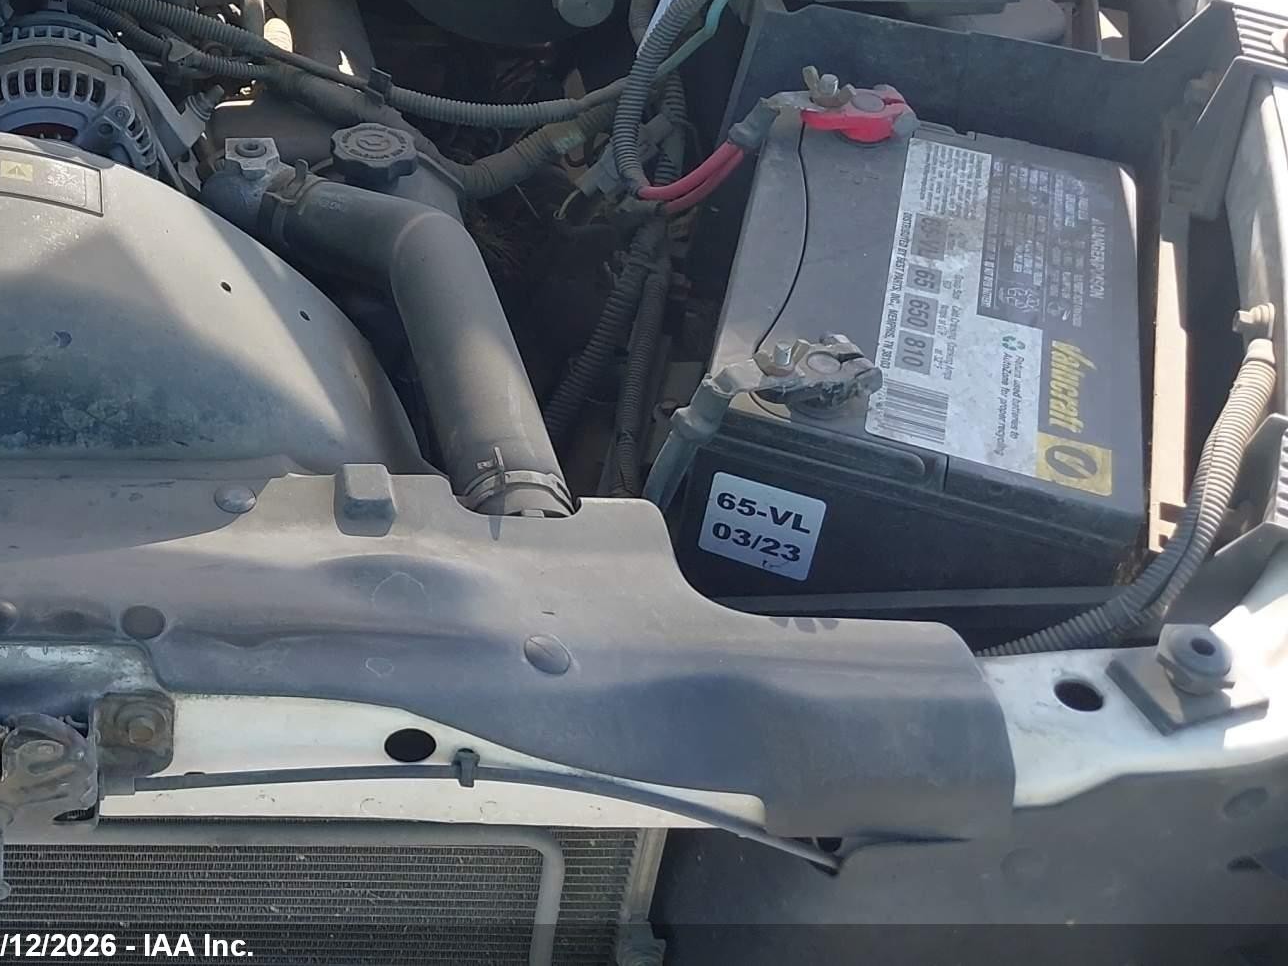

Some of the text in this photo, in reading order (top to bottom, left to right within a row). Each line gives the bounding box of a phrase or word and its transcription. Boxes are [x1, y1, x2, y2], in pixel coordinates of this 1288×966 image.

[894, 256, 905, 272] BEST
[914, 268, 935, 289] 65
[906, 298, 929, 328] 650
[901, 336, 925, 367] 810
[1000, 351, 1012, 386] AutoZone
[999, 386, 1009, 397] for
[1012, 379, 1023, 397] used
[1048, 340, 1098, 433] Valucraft
[997, 396, 1007, 421] proper
[1009, 430, 1019, 440] to
[716, 492, 811, 534] 65-VL
[712, 522, 801, 562] 03/23
